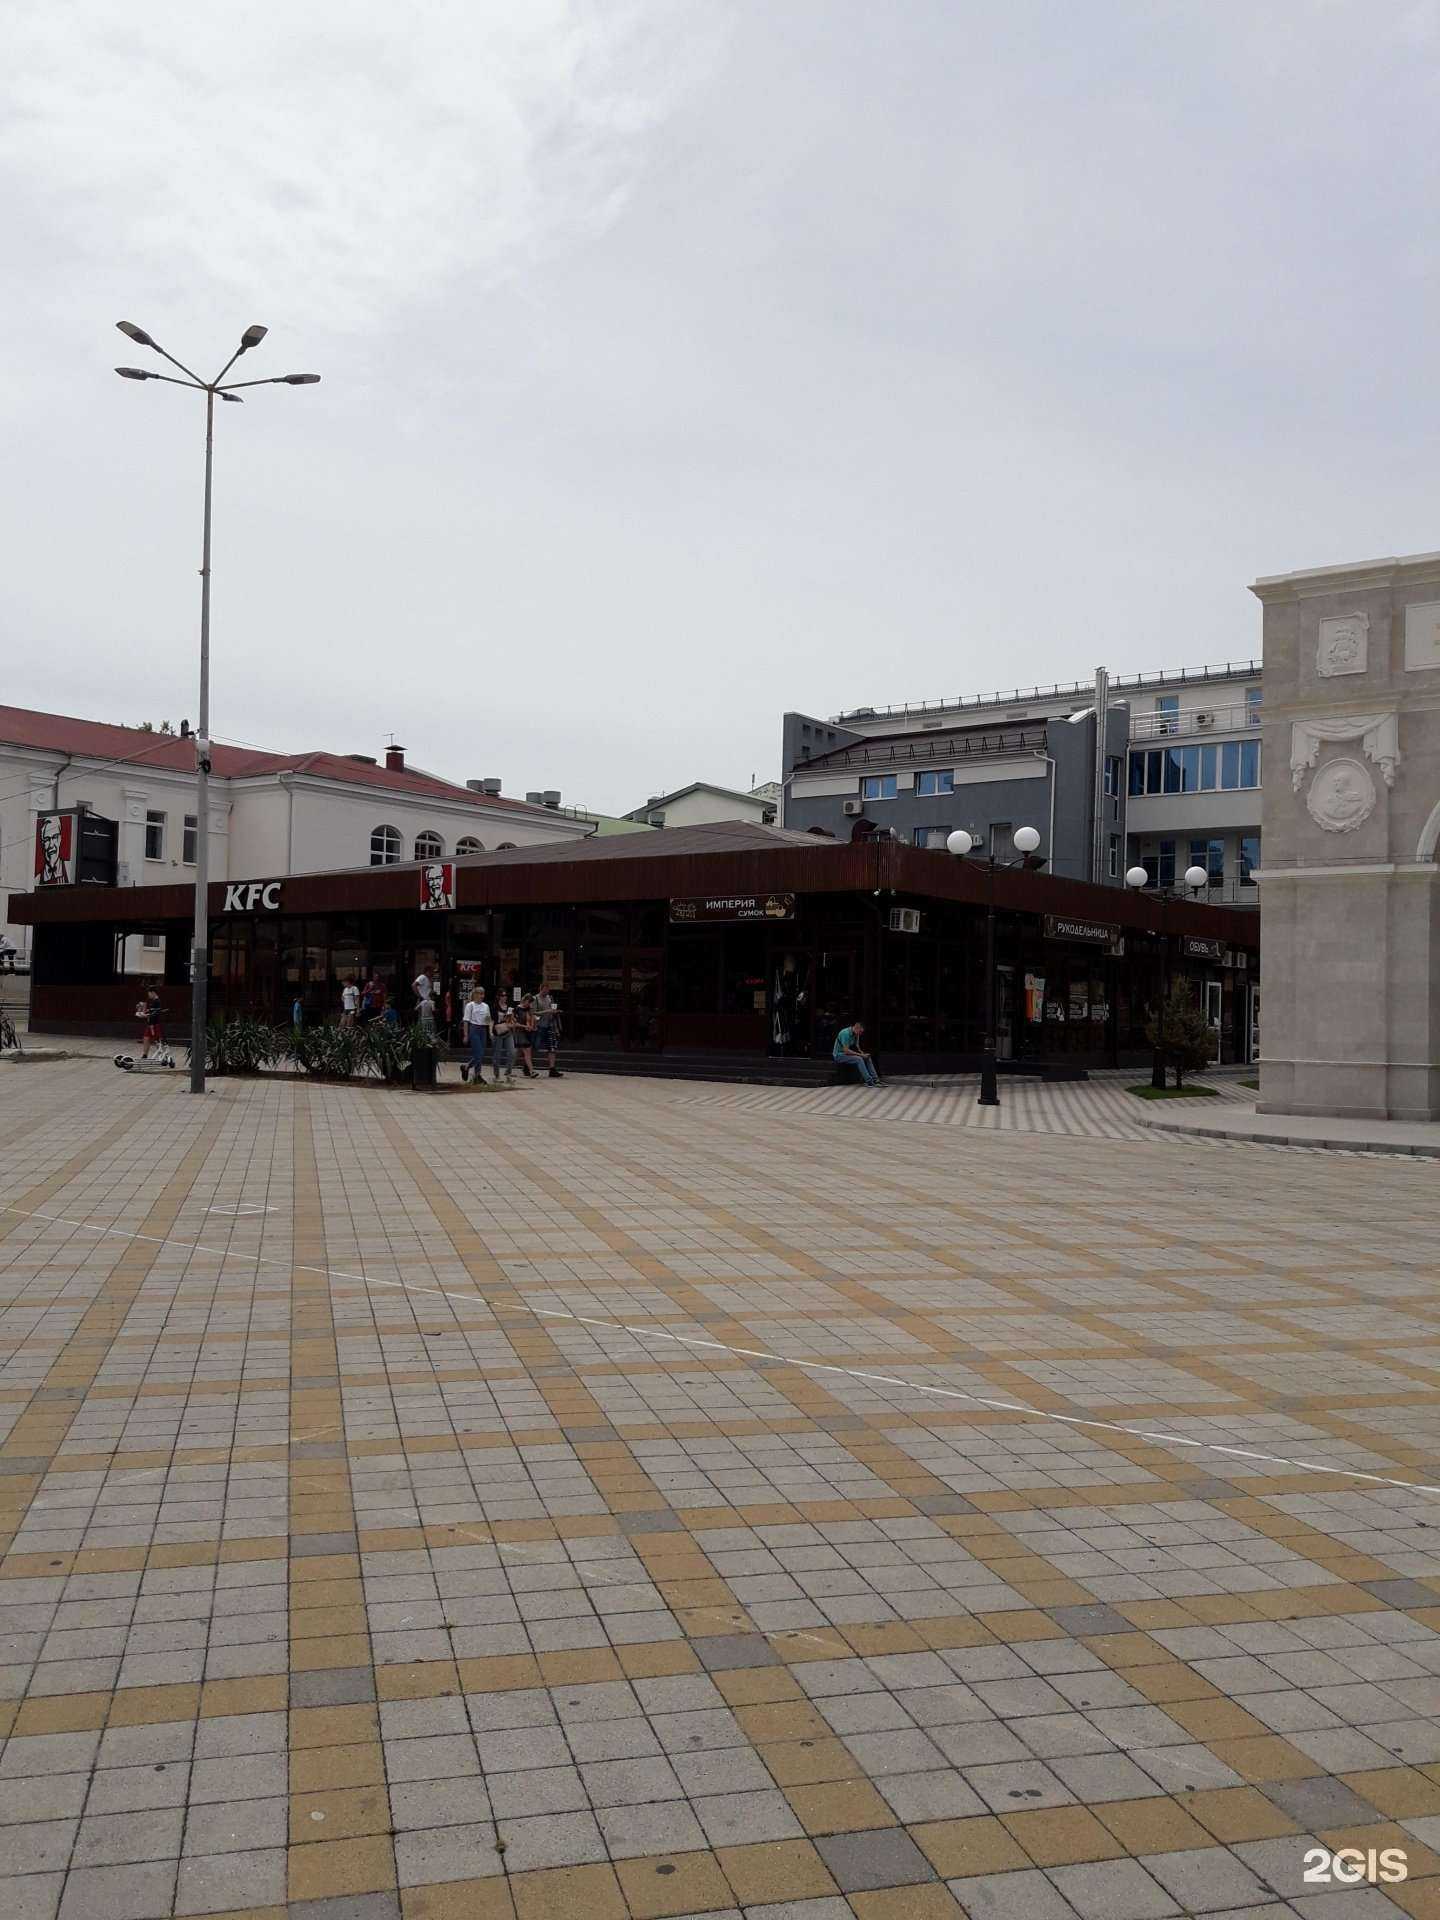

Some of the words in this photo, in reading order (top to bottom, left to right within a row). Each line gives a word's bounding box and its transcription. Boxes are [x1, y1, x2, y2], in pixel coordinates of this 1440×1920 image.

[222, 882, 281, 912] KFC
[705, 899, 756, 909] ИМПЕРИЯ
[738, 909, 765, 917] СУМОК
[1057, 922, 1109, 938] РУКОДЕЛЬНИЦА
